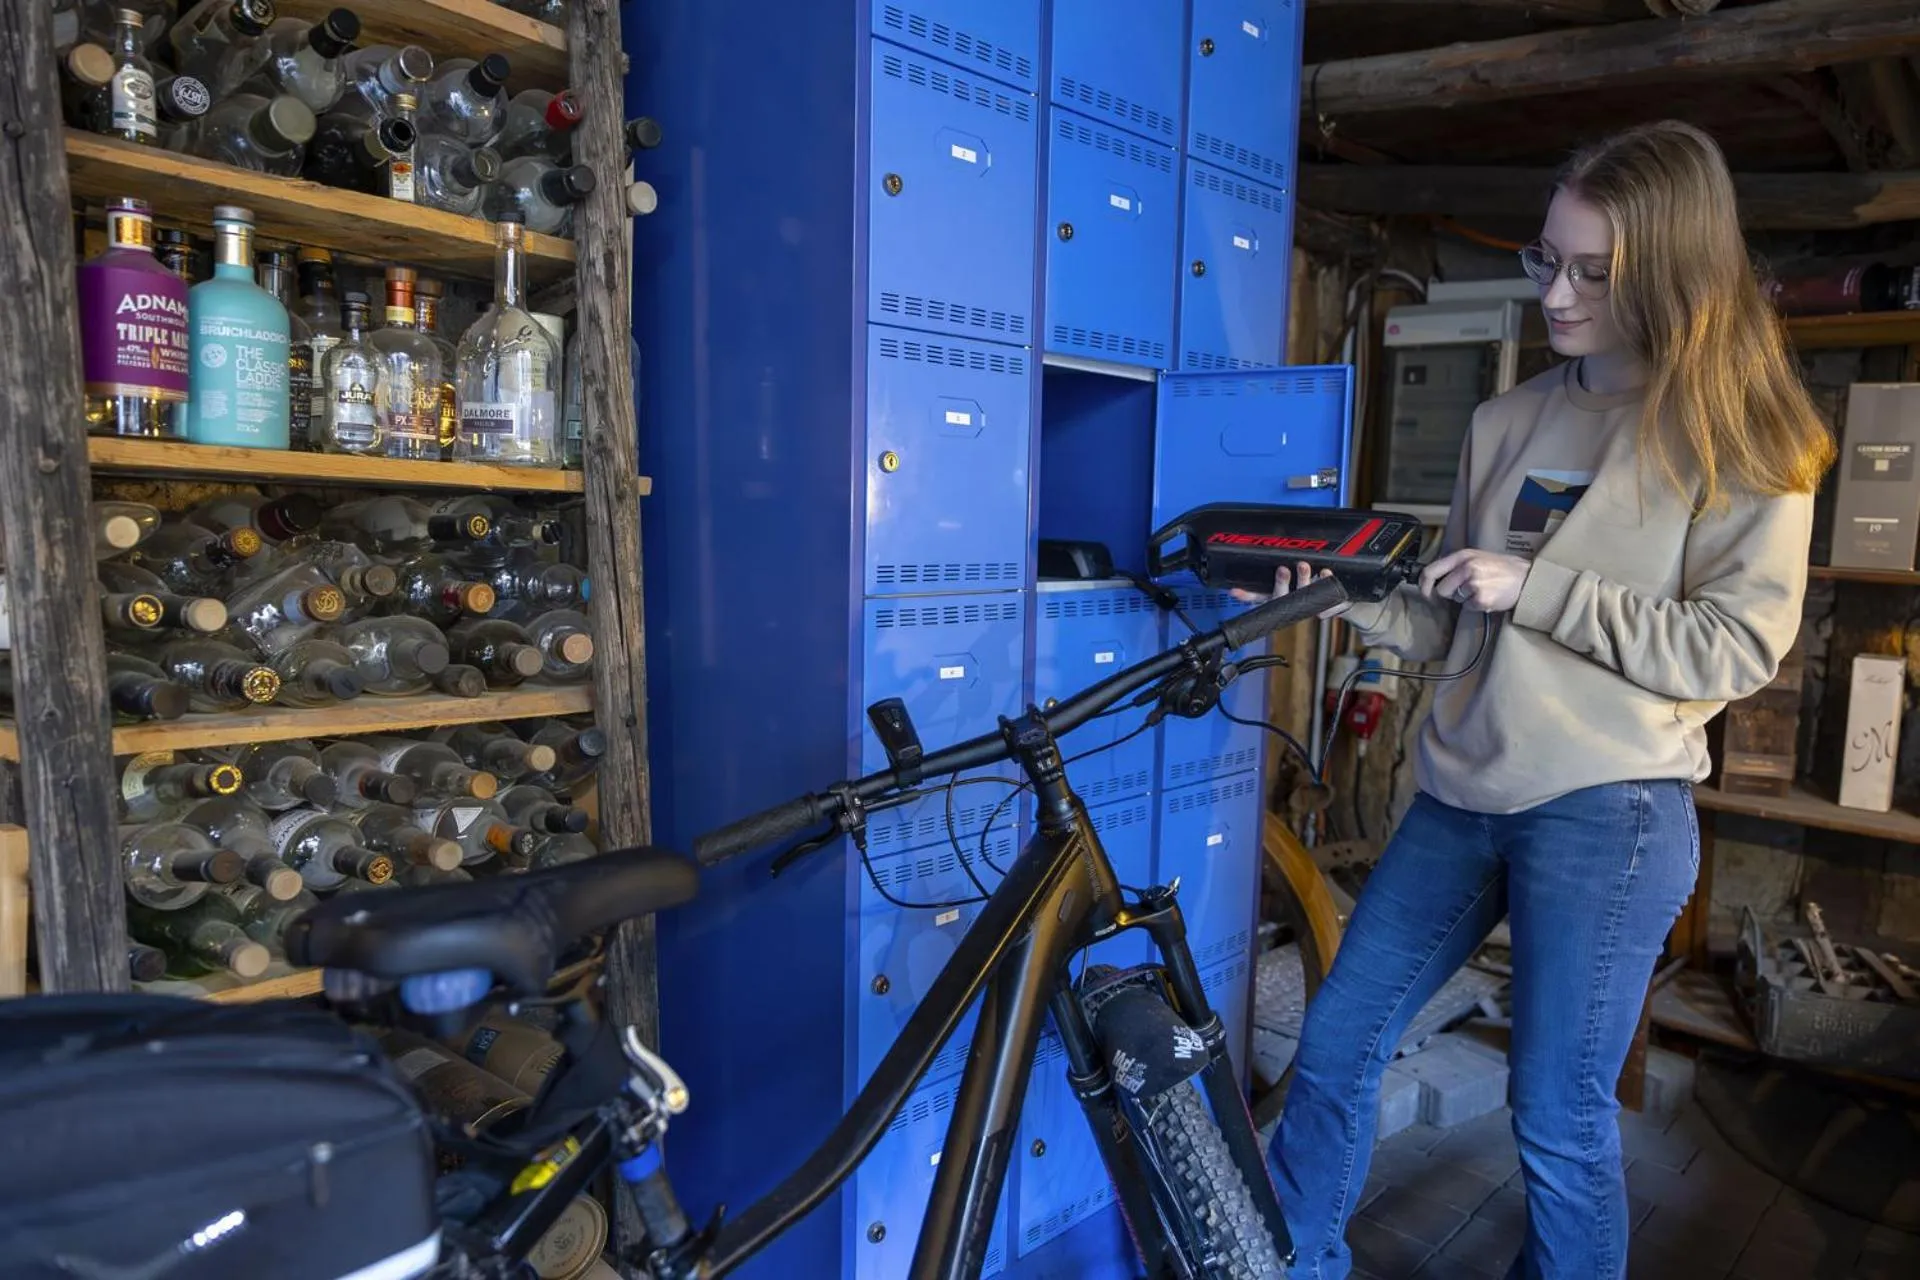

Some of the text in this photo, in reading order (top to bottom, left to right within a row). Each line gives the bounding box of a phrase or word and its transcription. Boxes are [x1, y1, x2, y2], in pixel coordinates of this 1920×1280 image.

[116, 293, 189, 322] ADNAM
[116, 322, 168, 345] TRIPLE
[235, 344, 264, 360] THE
[341, 391, 372, 400] JURA
[395, 415, 407, 425] PX
[464, 408, 510, 418] DALMORE
[1207, 533, 1328, 550] MERIDA
